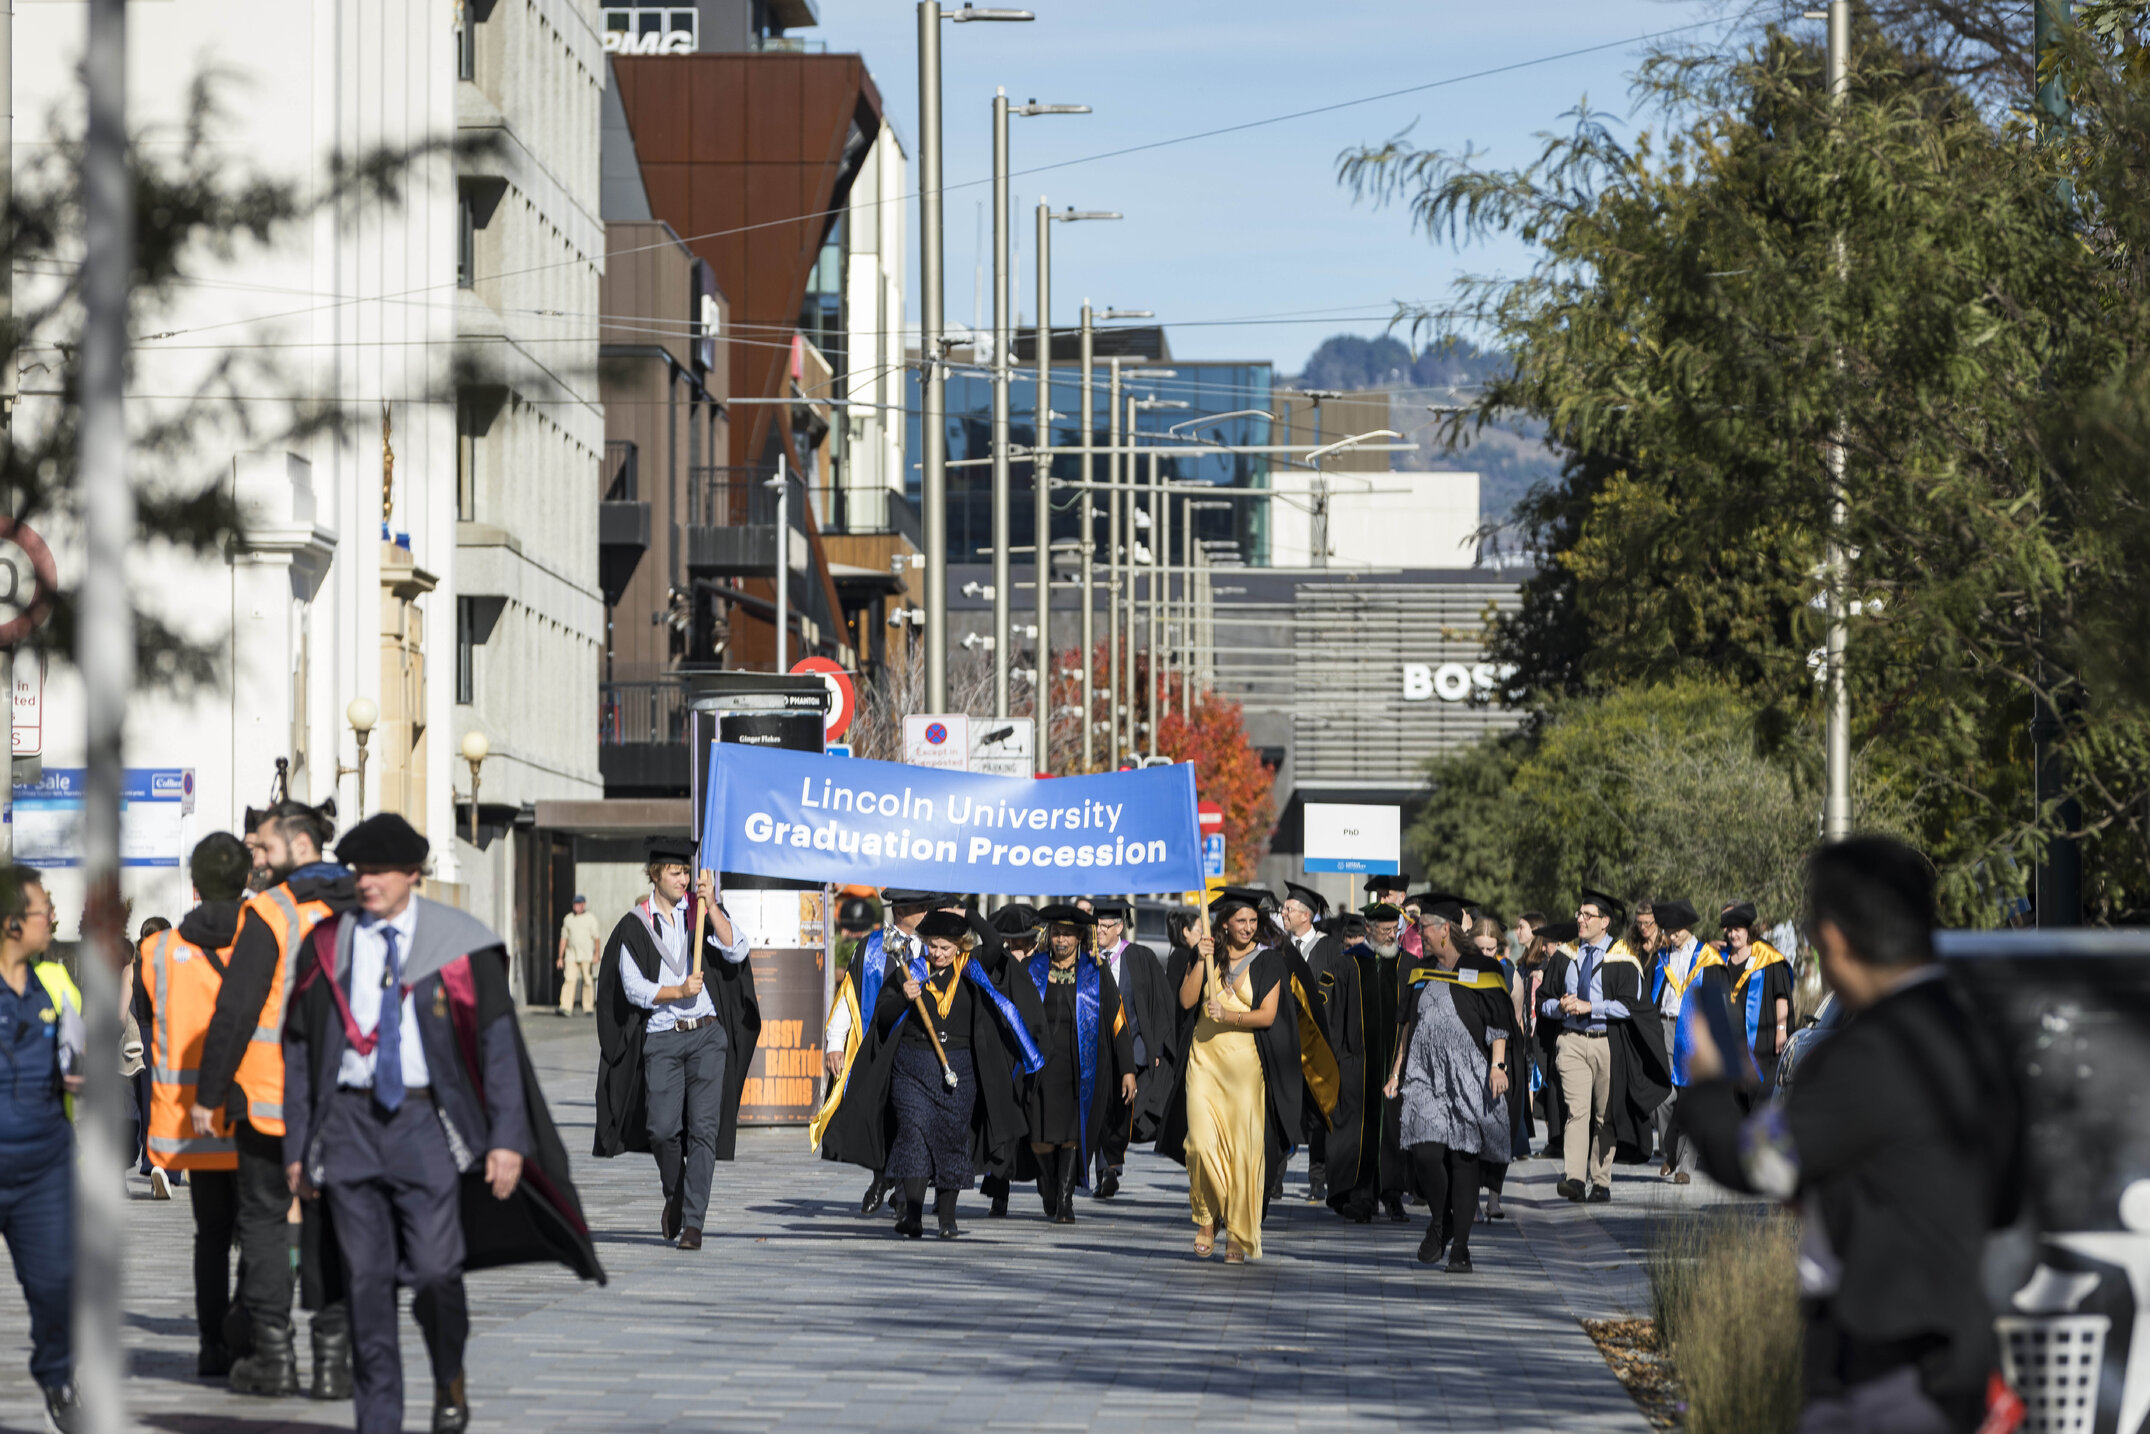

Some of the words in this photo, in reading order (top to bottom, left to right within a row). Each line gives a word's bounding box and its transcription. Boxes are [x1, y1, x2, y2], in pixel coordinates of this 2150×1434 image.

[739, 735, 760, 744] Ginger
[761, 735, 781, 743] Flakes
[916, 747, 946, 757] Except
[982, 763, 1016, 773] PARKING
[801, 776, 933, 821] Lincoln
[946, 795, 1123, 833] University
[744, 812, 957, 864] Graduation
[967, 835, 1167, 868] Procession
[740, 1077, 813, 1106] BRAHMS
